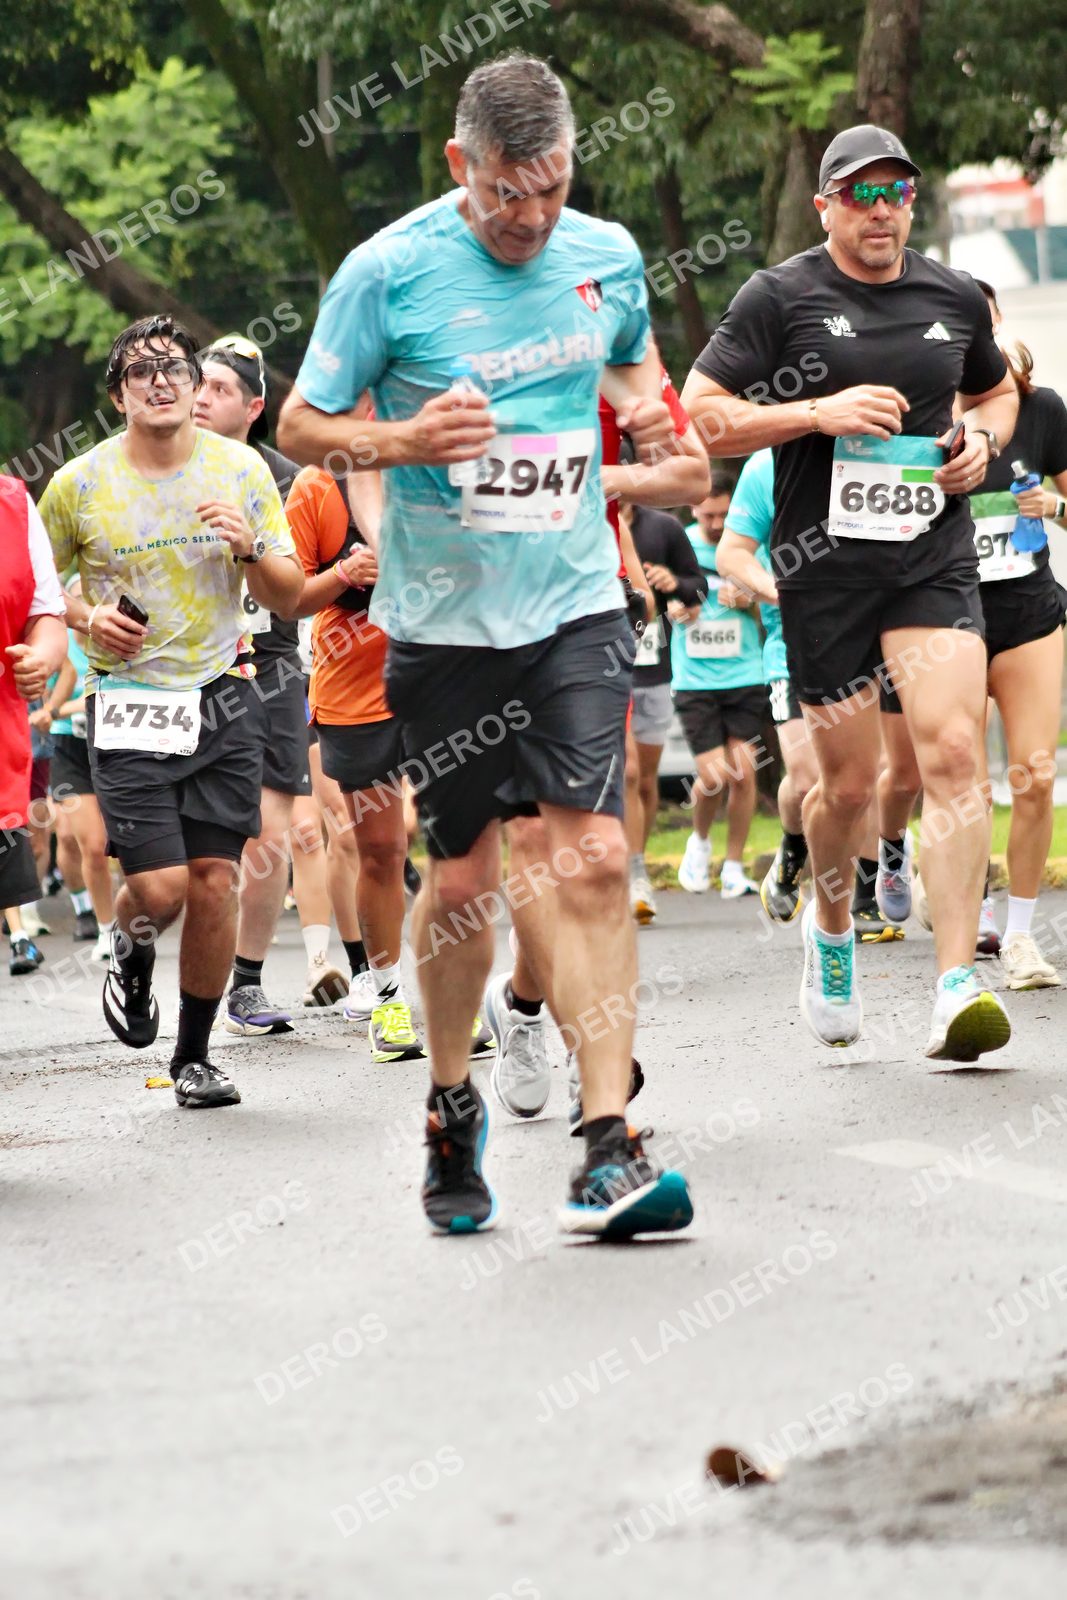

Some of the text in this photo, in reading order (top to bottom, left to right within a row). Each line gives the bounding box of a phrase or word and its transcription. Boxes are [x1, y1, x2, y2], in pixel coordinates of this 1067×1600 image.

[474, 456, 588, 497] 2947
[840, 481, 937, 516] 6688
[114, 534, 225, 556] TRAIL MÉXICO SERIE
[976, 532, 1019, 560] 97
[691, 629, 736, 645] 6666
[102, 703, 194, 732] 4734
